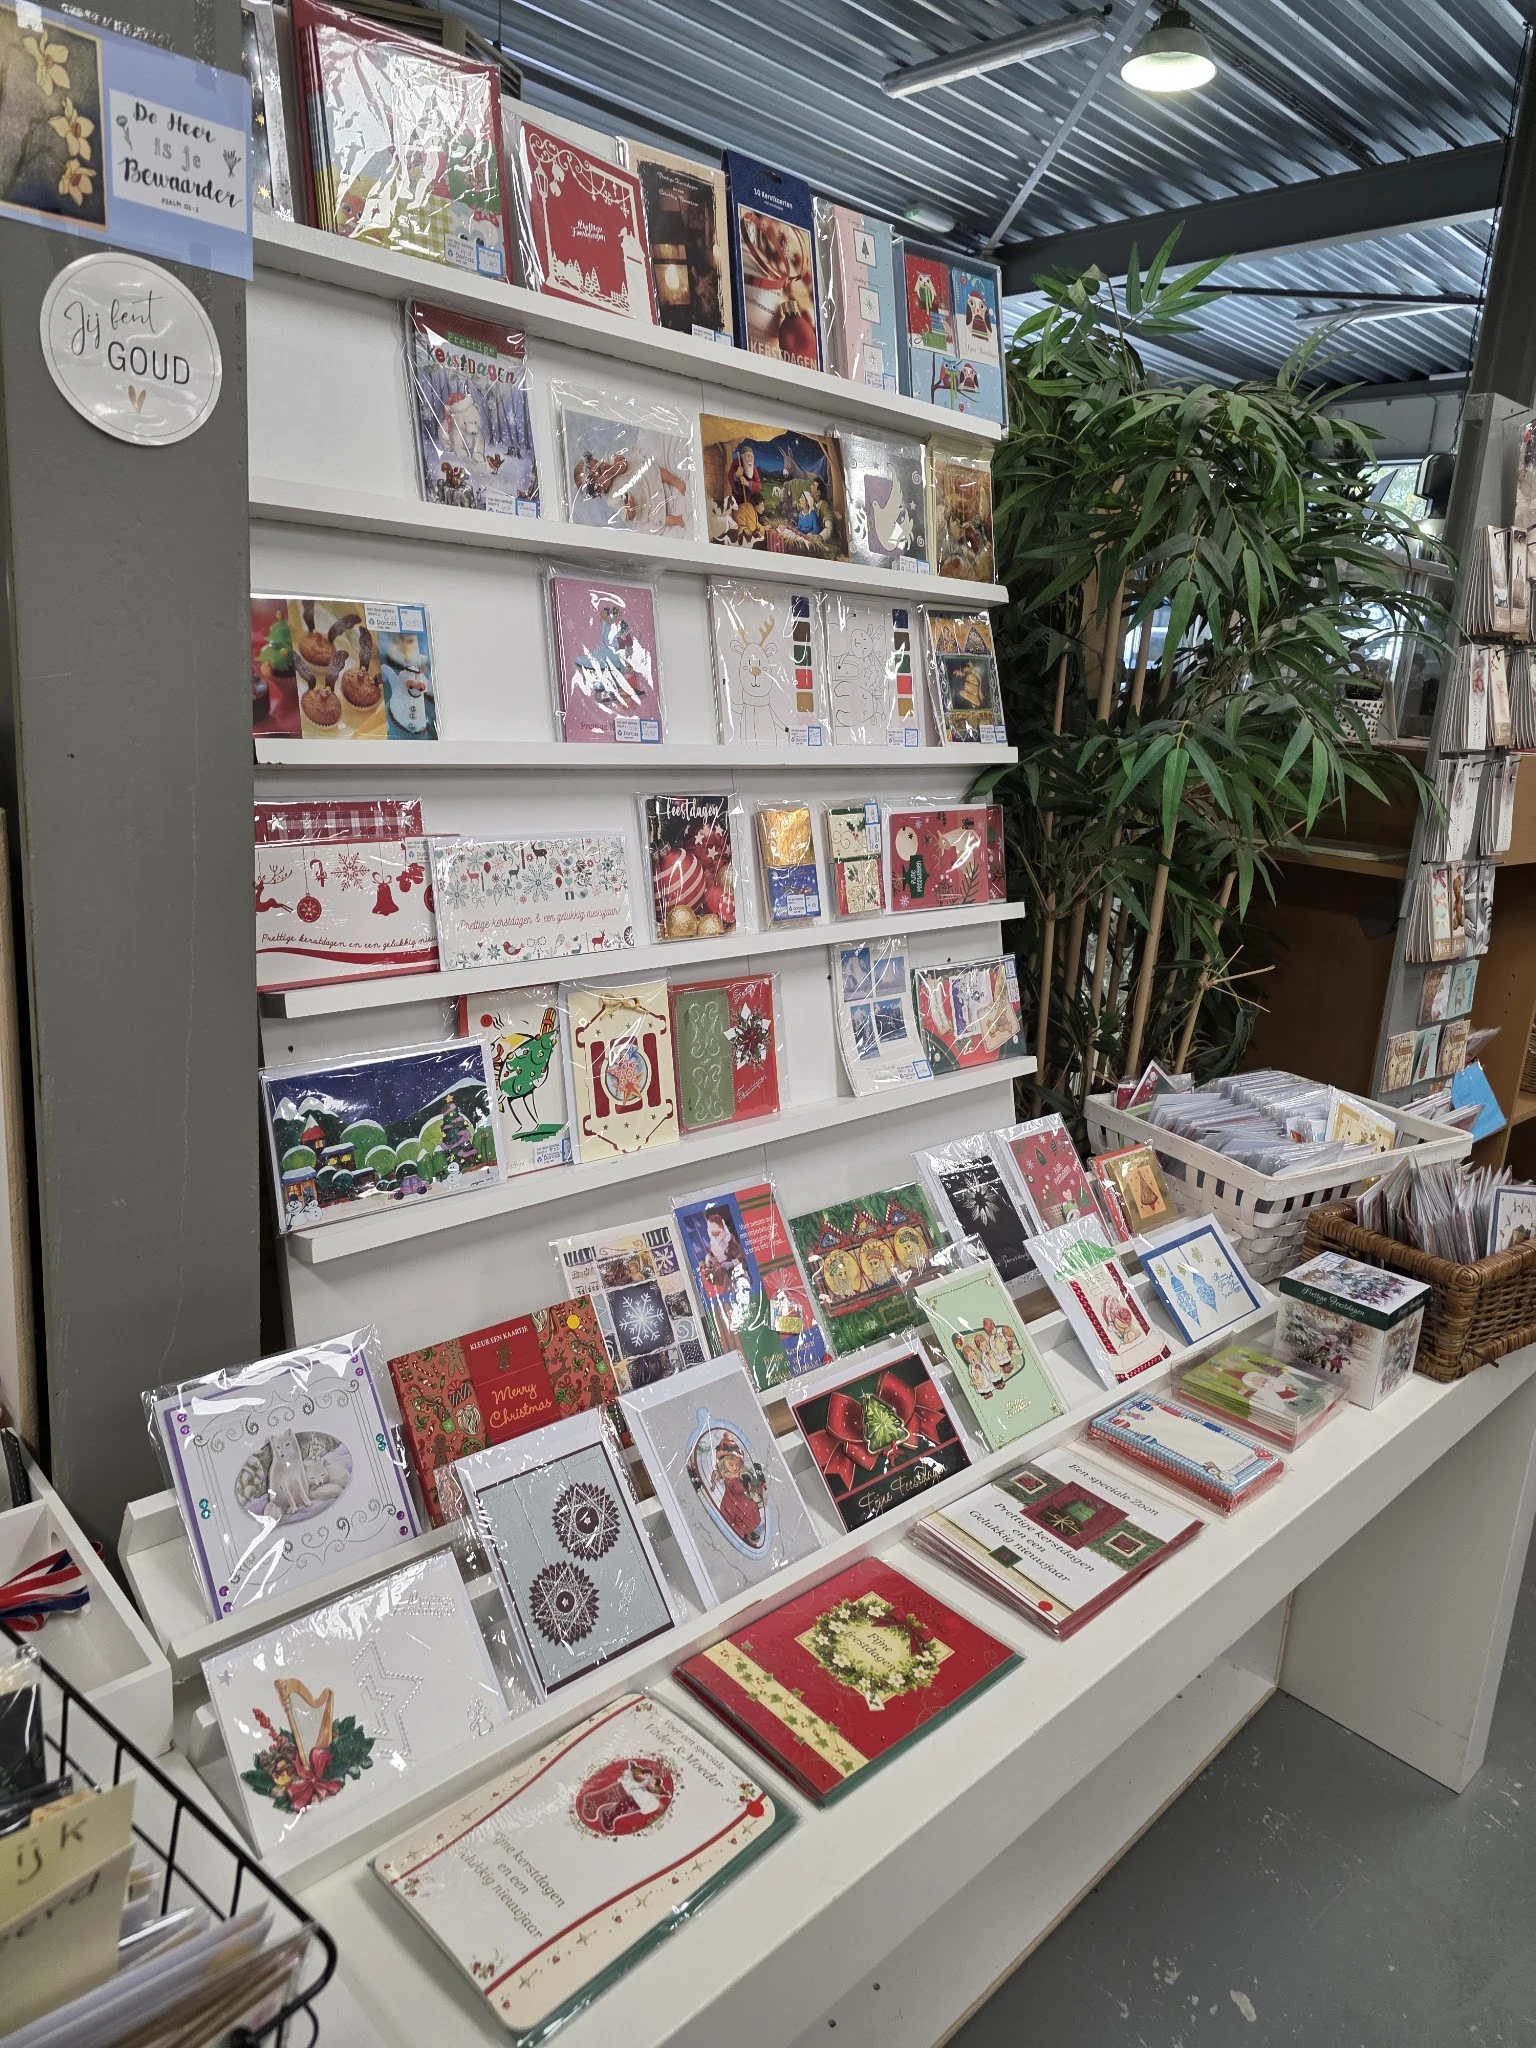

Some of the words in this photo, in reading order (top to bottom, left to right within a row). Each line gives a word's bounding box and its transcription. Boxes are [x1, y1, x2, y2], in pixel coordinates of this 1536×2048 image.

[133, 101, 157, 124] De
[167, 112, 216, 143] Heer
[154, 137, 173, 160] is
[181, 145, 201, 172] je
[117, 156, 243, 208] Bewaarder
[64, 300, 100, 356] Jij
[109, 290, 163, 334] bent
[107, 341, 190, 385] GOUD
[448, 332, 495, 356] Prettige
[750, 340, 817, 370] KERSTDAGEN
[262, 933, 296, 942] Prettige
[299, 933, 346, 949] kerstdagen
[383, 938, 416, 951] gelukkig
[457, 918, 490, 933] Prettige
[492, 914, 532, 928] kerstdagen
[543, 914, 555, 922] een
[557, 910, 585, 924] gelukkig
[1301, 1286, 1327, 1304] Prettige
[1329, 1295, 1365, 1318] Feestdagen
[470, 1338, 490, 1350] KLEUR
[490, 1333, 502, 1344] EEN
[503, 1325, 528, 1341] KAARTJE
[489, 1399, 552, 1429] Christmas
[491, 1383, 537, 1405] Merry
[858, 1491, 892, 1516] Fijne
[890, 1464, 948, 1495] Feestdagn
[1067, 1463, 1089, 1477] Een
[1088, 1473, 1130, 1501] speciale
[1129, 1497, 1159, 1516] Zoon
[968, 1509, 1015, 1545] Gelukkig
[1013, 1542, 1071, 1583] nieuwjaar
[993, 1502, 1035, 1533] Prettige
[1035, 1529, 1095, 1573] kerstdagen
[1012, 1527, 1027, 1539] en
[1026, 1537, 1046, 1553] een
[843, 1630, 897, 1671] feestdagen
[867, 1632, 893, 1654] Fijne
[645, 1723, 676, 1745] Vader
[682, 1753, 724, 1787] Moeder
[664, 1719, 682, 1734] Voor
[681, 1734, 696, 1746] een
[694, 1745, 726, 1771] speciale
[497, 1863, 512, 1877] en
[510, 1875, 529, 1895] een
[513, 1849, 565, 1909] kerstdagen
[492, 1883, 543, 1938] nieuwjaar
